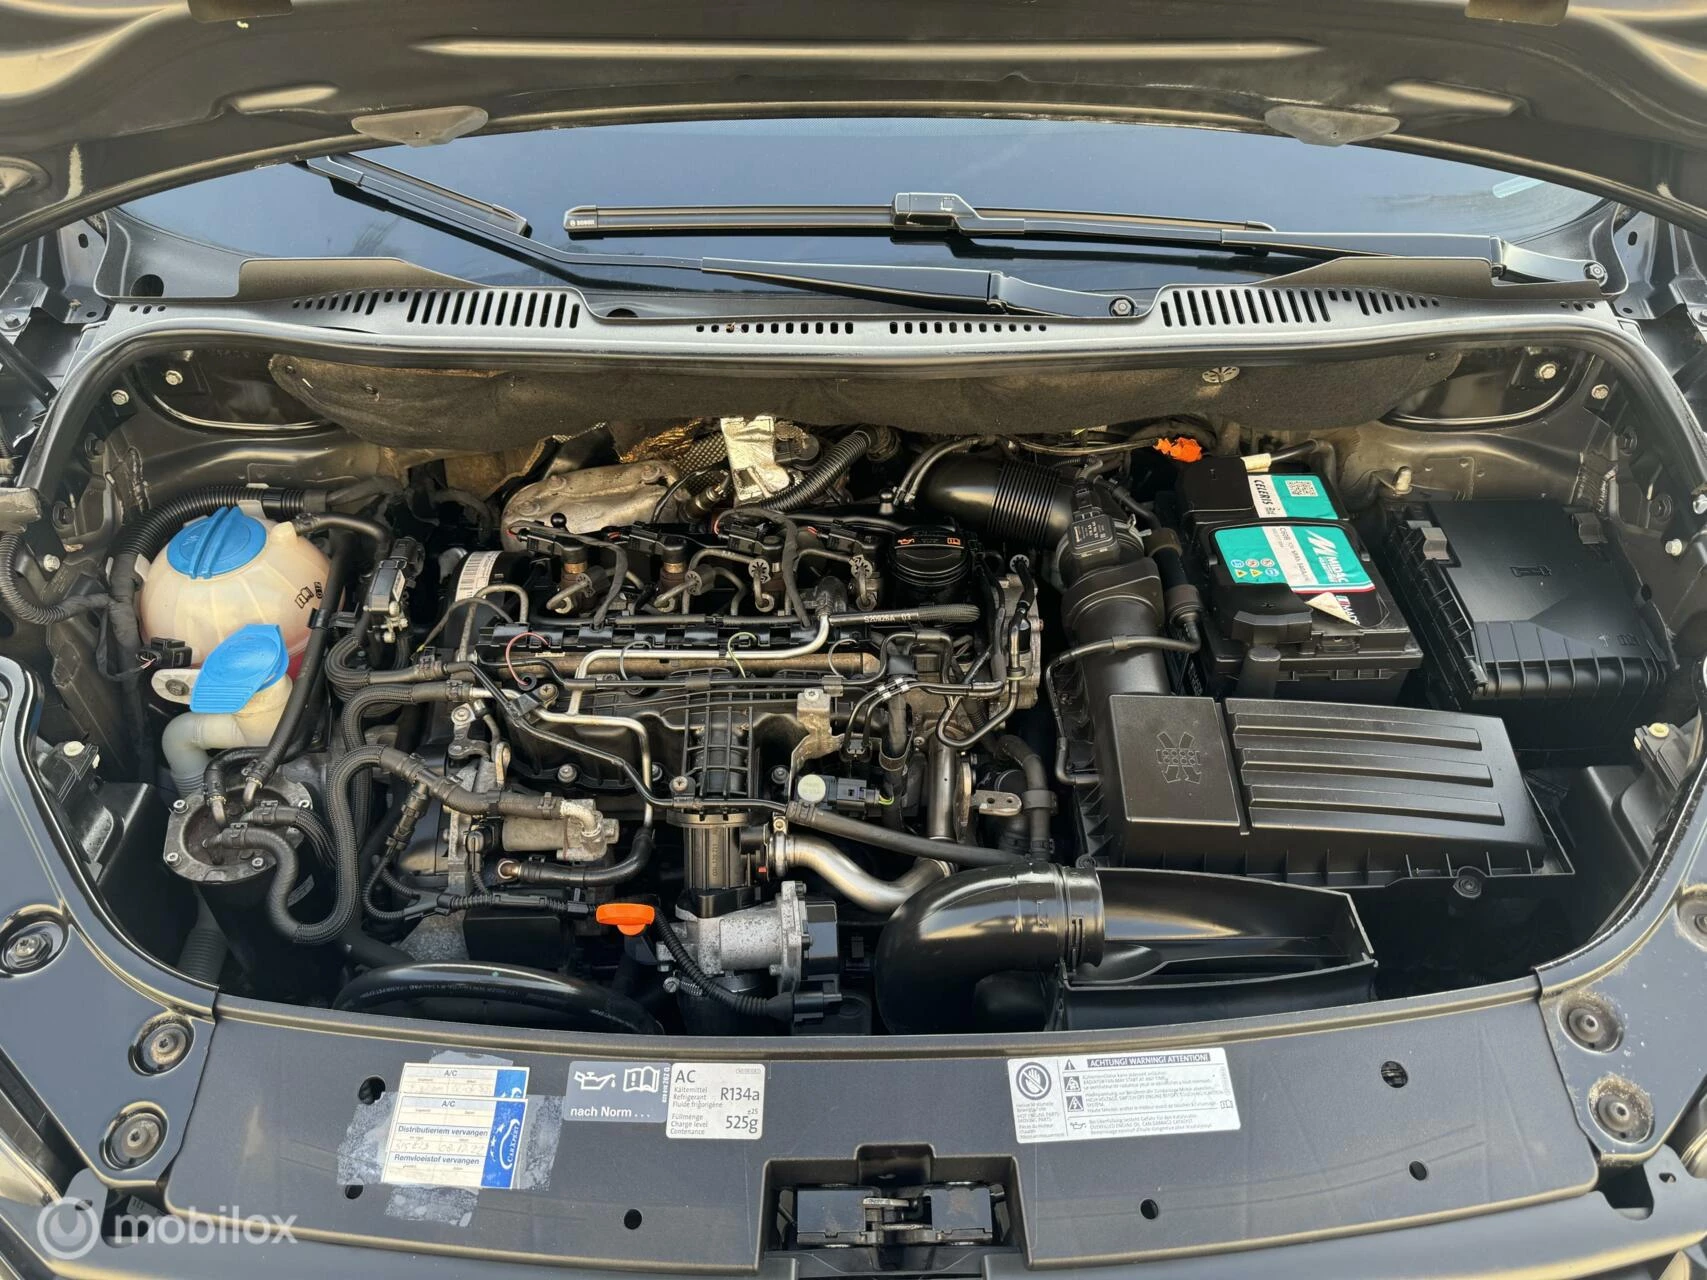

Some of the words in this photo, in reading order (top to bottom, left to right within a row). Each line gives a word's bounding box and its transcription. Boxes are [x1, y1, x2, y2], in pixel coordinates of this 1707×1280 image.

[1253, 479, 1273, 505] CELERIS
[1090, 1058, 1128, 1067] ACHTUNG!
[1129, 1056, 1166, 1065] WARNING!
[1167, 1053, 1209, 1063] ATTENTION!
[443, 1069, 458, 1077] A/C
[674, 1069, 697, 1084] AC
[720, 1086, 760, 1101] R134a
[441, 1100, 456, 1108] A/C
[570, 1106, 600, 1118] nach
[600, 1106, 632, 1118] Norm
[398, 1125, 450, 1135] Distributieriem
[451, 1129, 488, 1137] vervangen
[725, 1115, 759, 1134] 525g
[394, 1153, 442, 1163] Remvloeistof
[442, 1157, 480, 1166] vervangen
